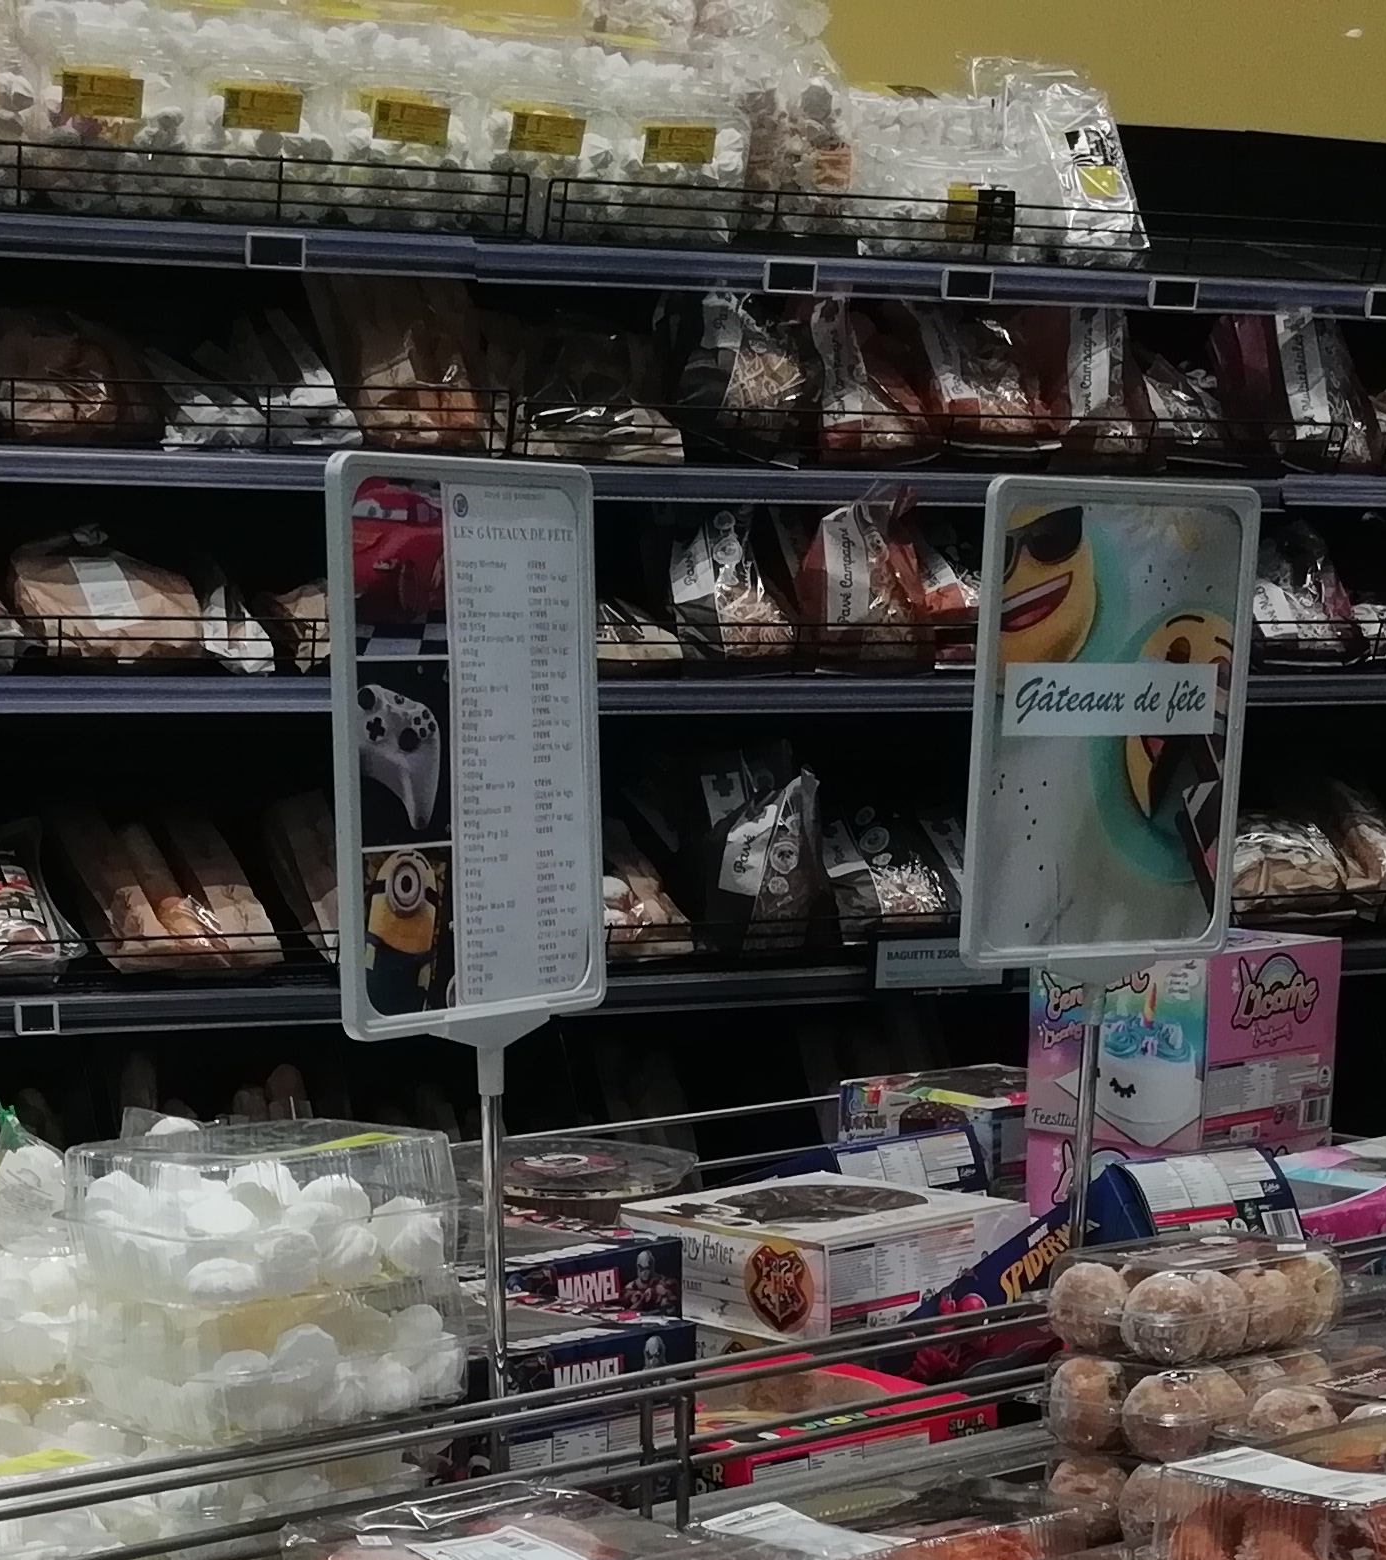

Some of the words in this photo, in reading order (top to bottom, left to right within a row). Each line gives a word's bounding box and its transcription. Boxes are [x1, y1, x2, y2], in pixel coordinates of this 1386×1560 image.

[453, 526, 474, 540] LES
[477, 525, 528, 541] GÂTEAUX
[529, 527, 546, 542] DE
[547, 526, 575, 543] FÊTE
[839, 526, 857, 589] Campagne
[836, 589, 851, 625] Pavé
[1015, 676, 1126, 724] Gâteaux
[1133, 682, 1162, 712] de
[1165, 679, 1207, 724] fête
[732, 832, 756, 874] Pavé
[886, 949, 936, 961] BAGUETTE
[1031, 1107, 1078, 1128] Feestta
[702, 1234, 735, 1266] Potter
[1000, 1219, 1101, 1305] SPIDER-M
[557, 1267, 620, 1304] MARVEL
